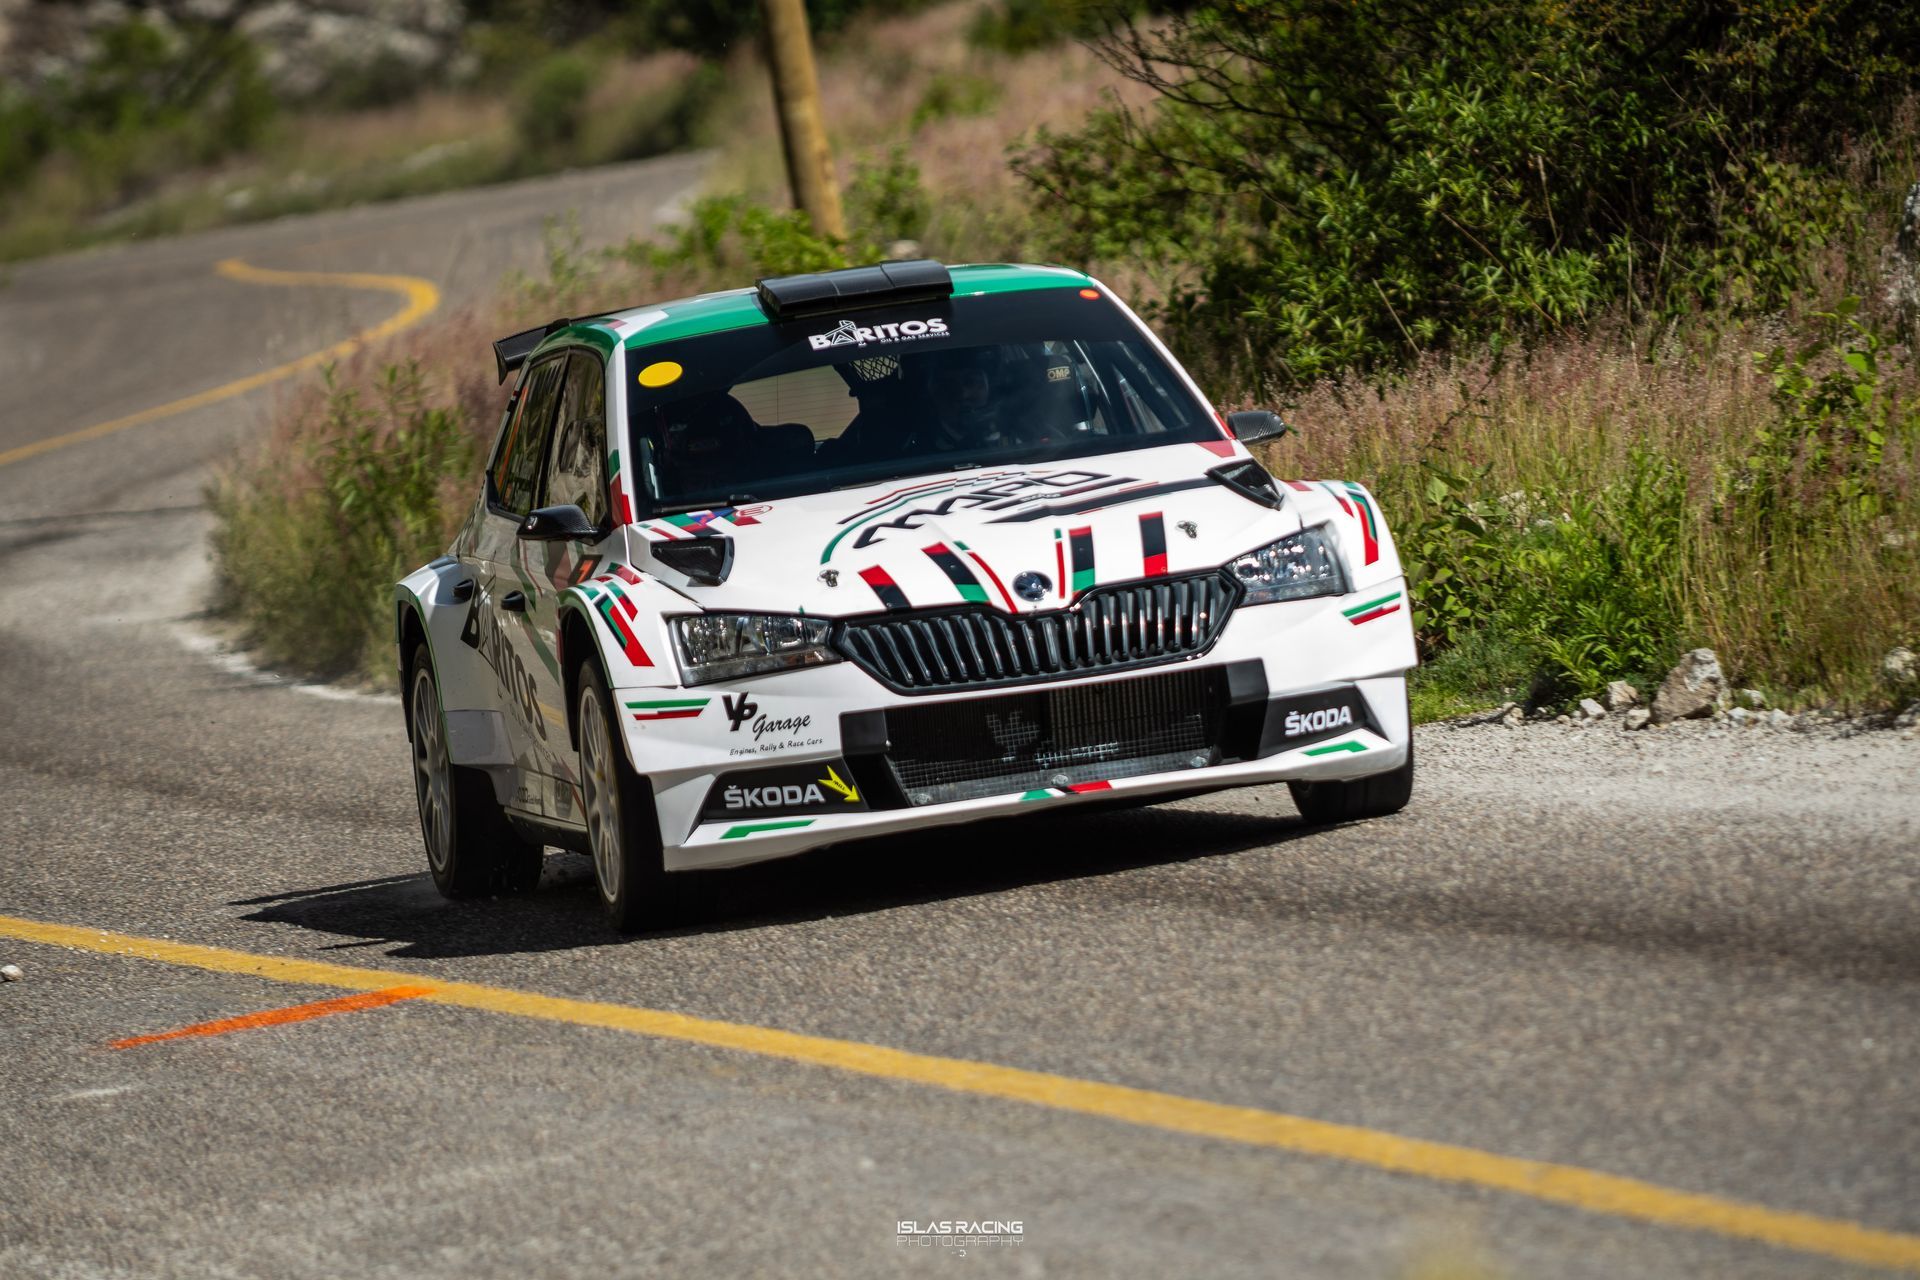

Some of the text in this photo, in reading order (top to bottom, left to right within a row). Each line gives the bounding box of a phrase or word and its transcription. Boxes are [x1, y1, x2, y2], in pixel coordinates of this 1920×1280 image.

[808, 318, 949, 351] BARITOS
[917, 331, 950, 340] SERVICES
[1047, 368, 1071, 380] OMP
[752, 713, 811, 742] Garage
[1284, 705, 1353, 737] ŠKODA
[729, 747, 757, 757] Engines,
[759, 744, 777, 752] Rally
[787, 740, 804, 748] Race
[724, 784, 826, 809] ŠKODA
